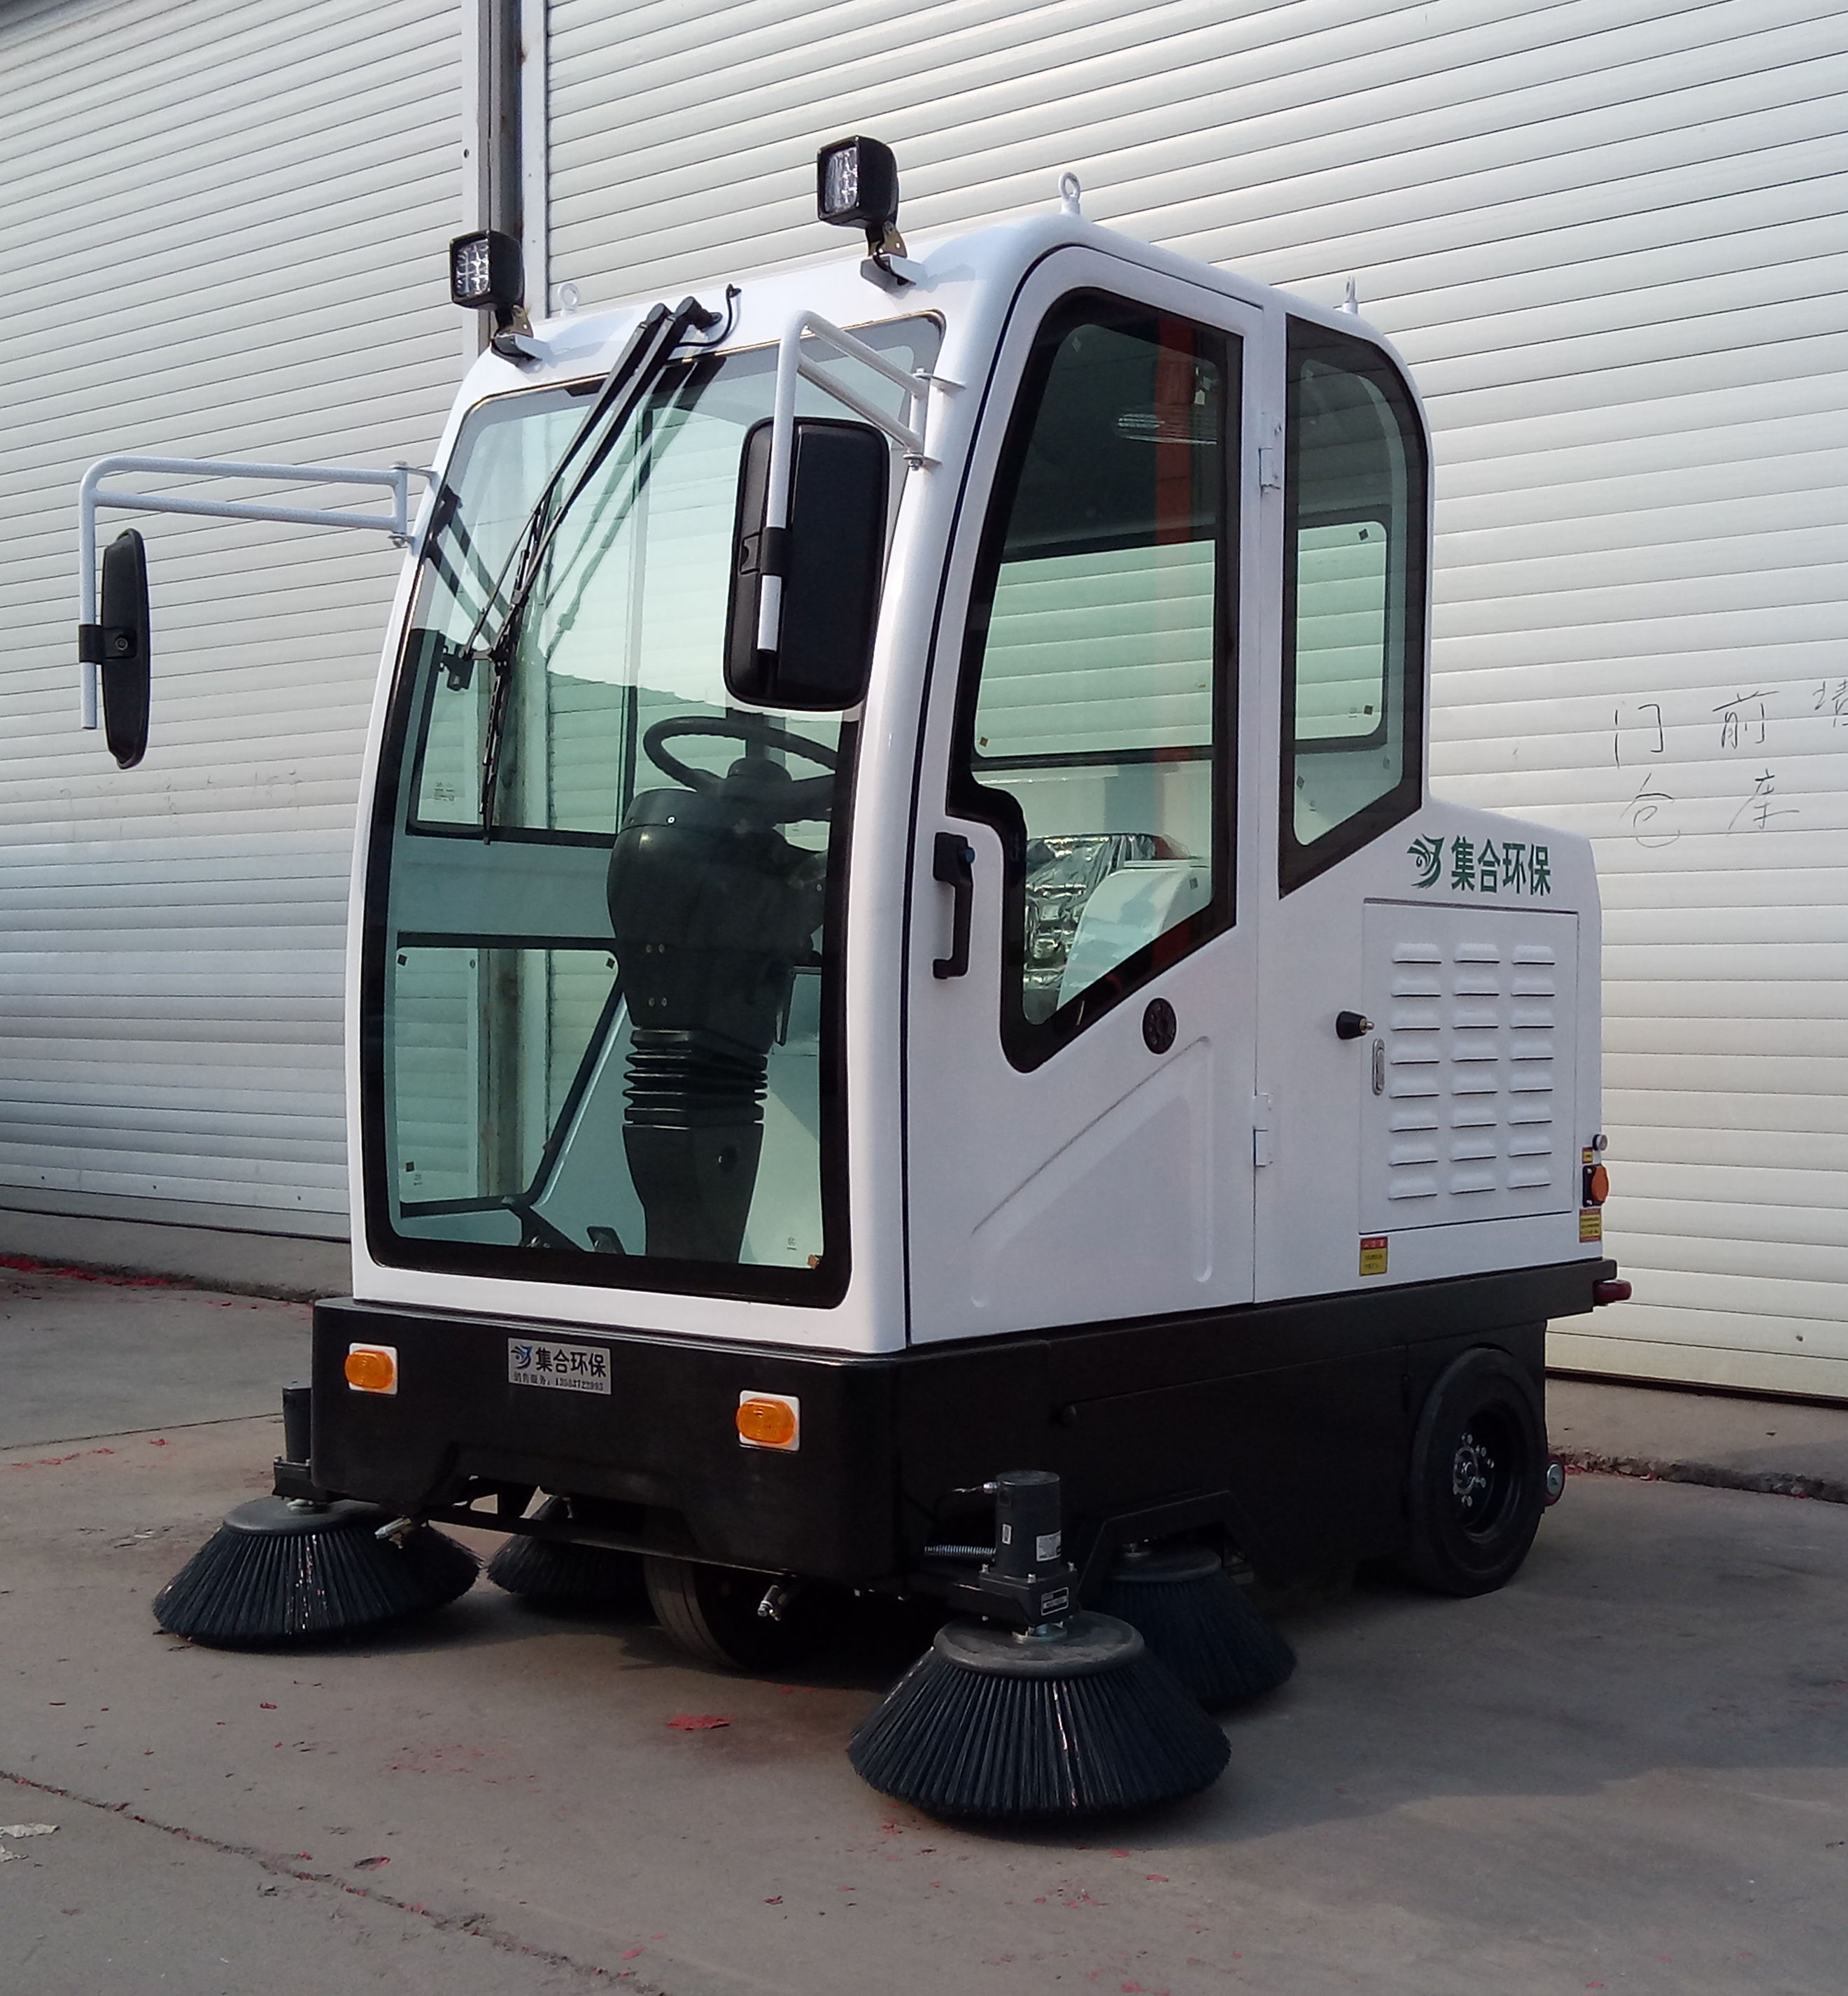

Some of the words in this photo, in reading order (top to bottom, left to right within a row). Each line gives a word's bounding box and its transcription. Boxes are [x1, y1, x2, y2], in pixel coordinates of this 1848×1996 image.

[1451, 834, 1551, 897] 集合环保
[535, 1347, 607, 1378] 集合环保
